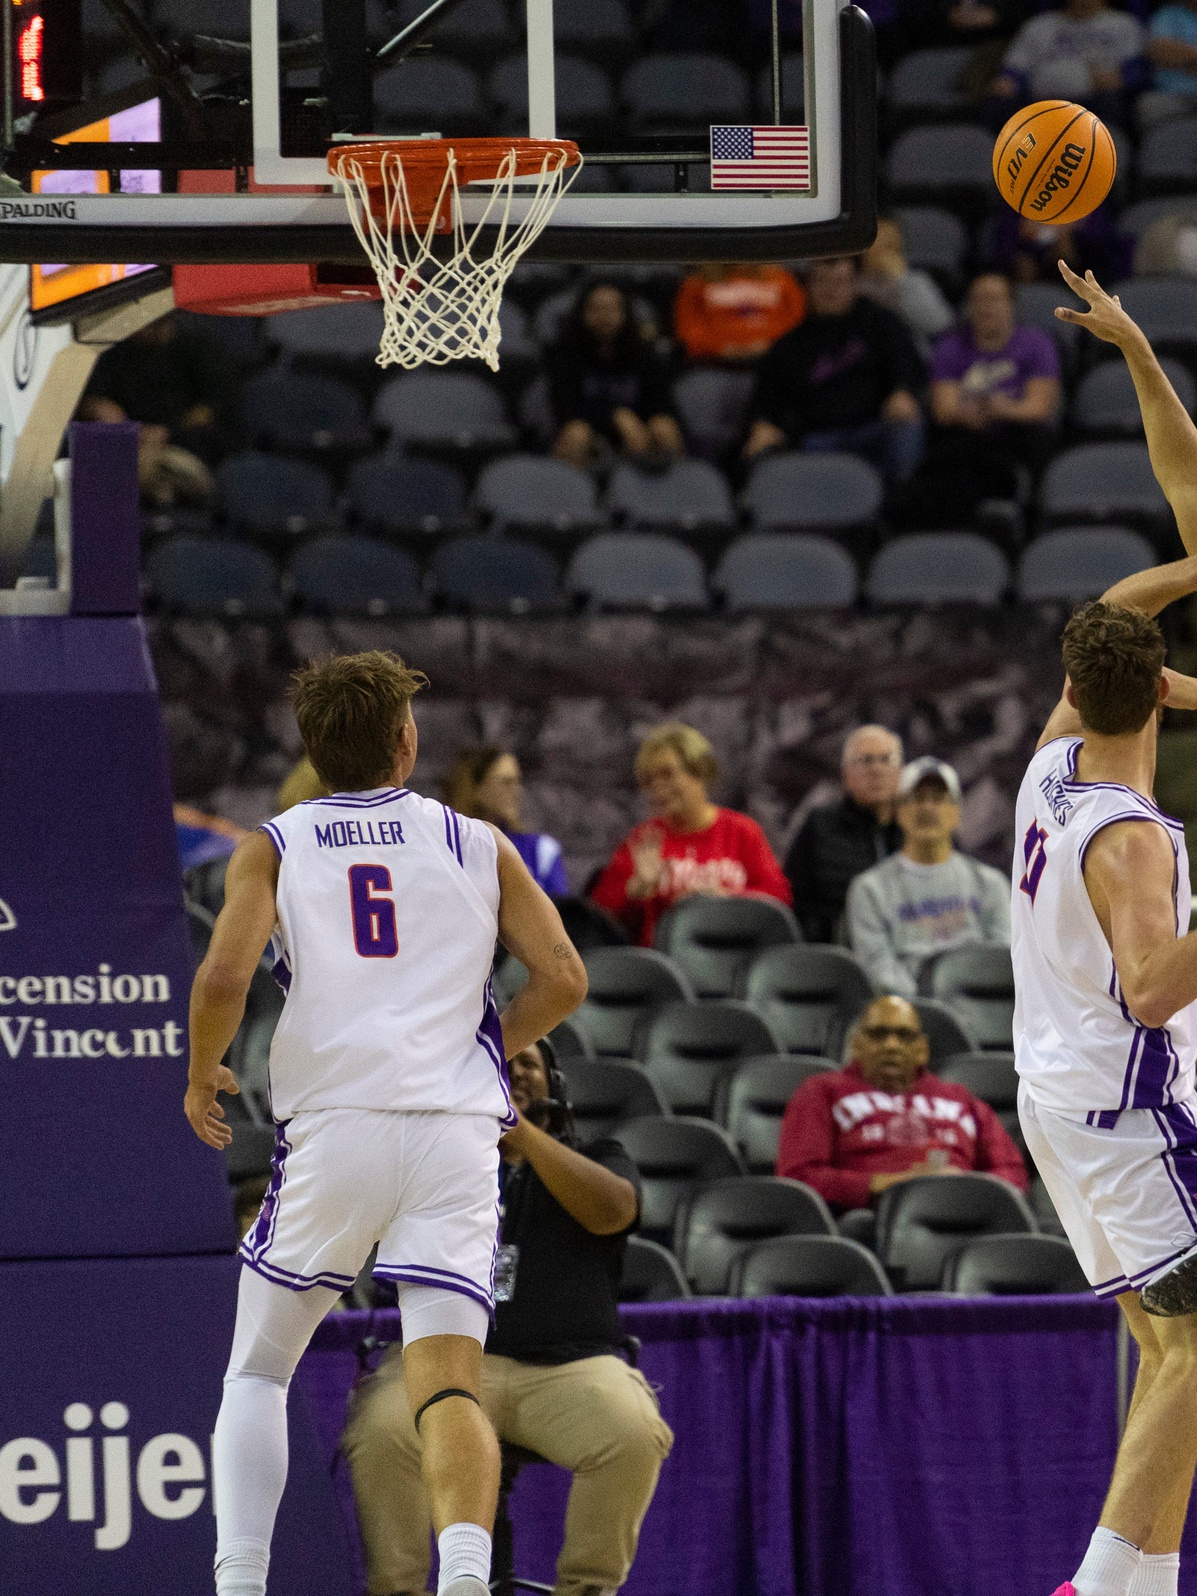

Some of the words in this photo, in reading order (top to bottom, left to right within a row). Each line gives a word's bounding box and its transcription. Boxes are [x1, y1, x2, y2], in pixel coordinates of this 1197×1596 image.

[1029, 142, 1087, 212] Wilson
[314, 821, 405, 848] MOELLER
[347, 863, 399, 958] 6
[0, 1401, 216, 1550] eije
